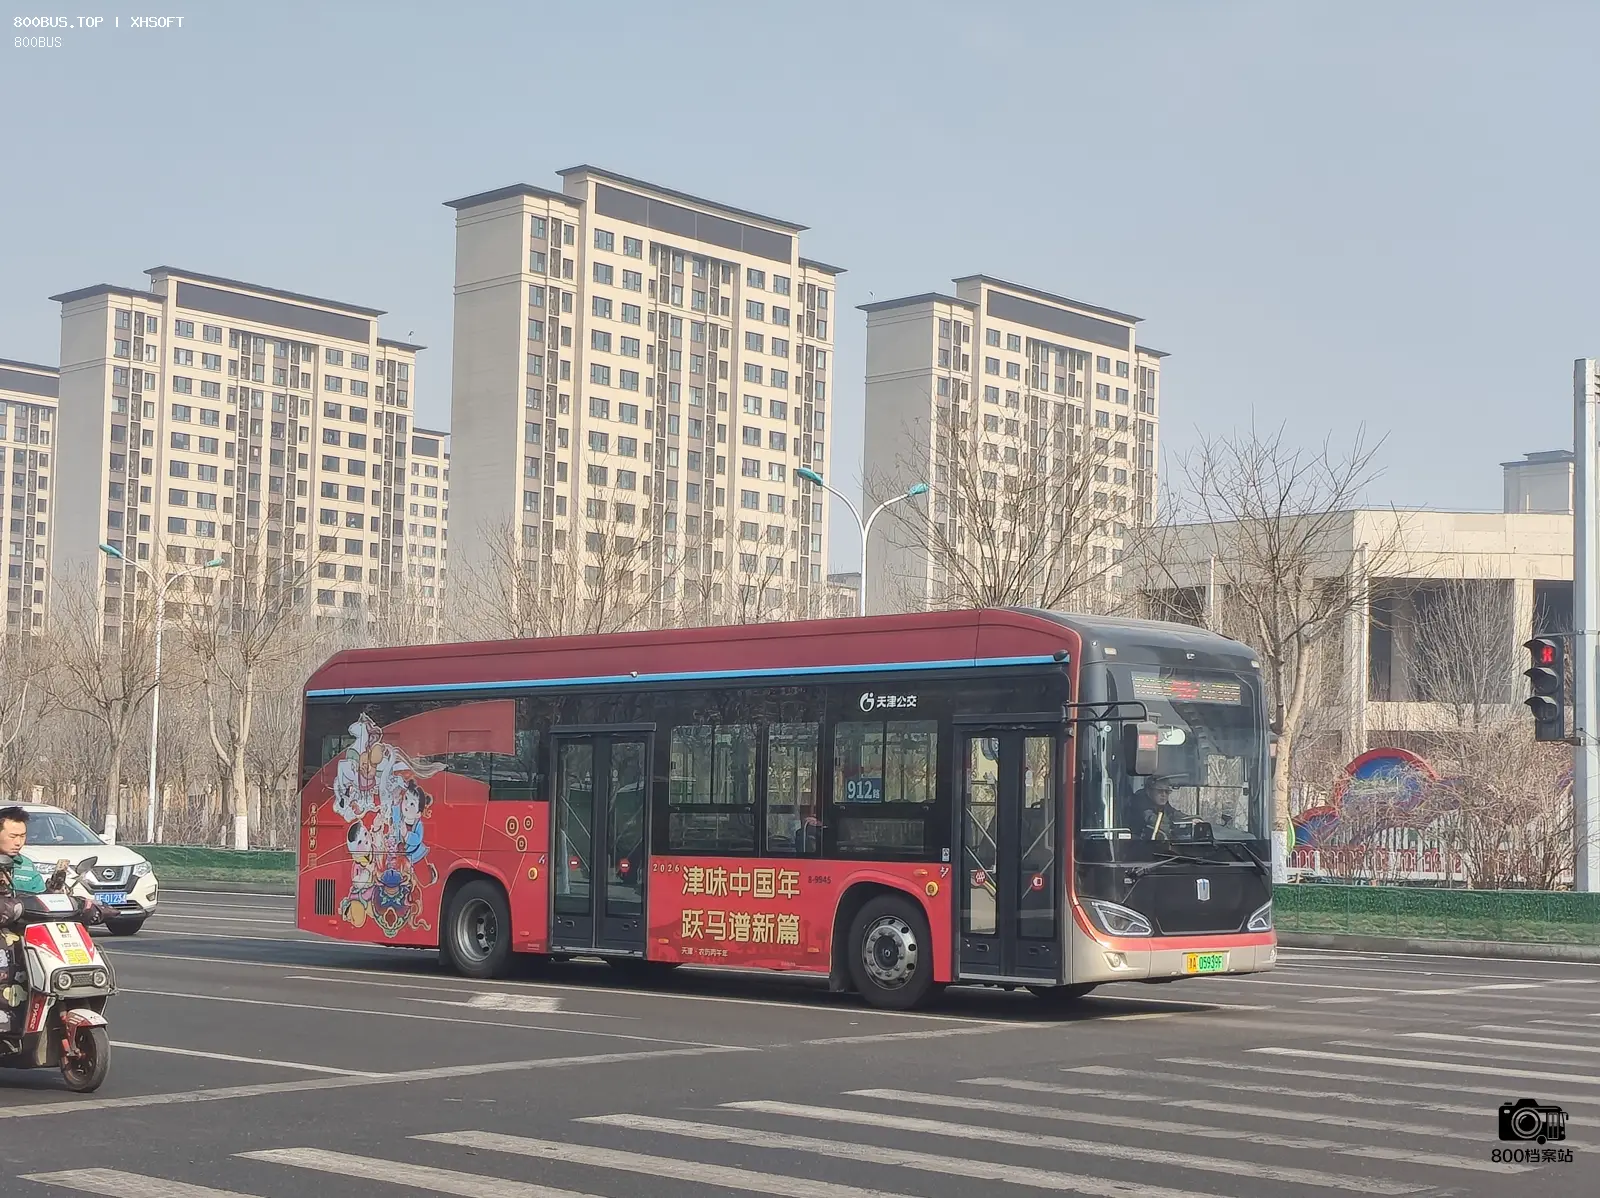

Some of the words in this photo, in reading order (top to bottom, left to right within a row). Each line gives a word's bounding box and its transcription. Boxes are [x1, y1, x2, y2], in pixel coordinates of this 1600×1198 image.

[876, 695, 918, 708] 天津公交
[652, 863, 680, 873] 2026
[682, 865, 800, 899] 津味中国年
[681, 909, 800, 945] 跃马谱新篇
